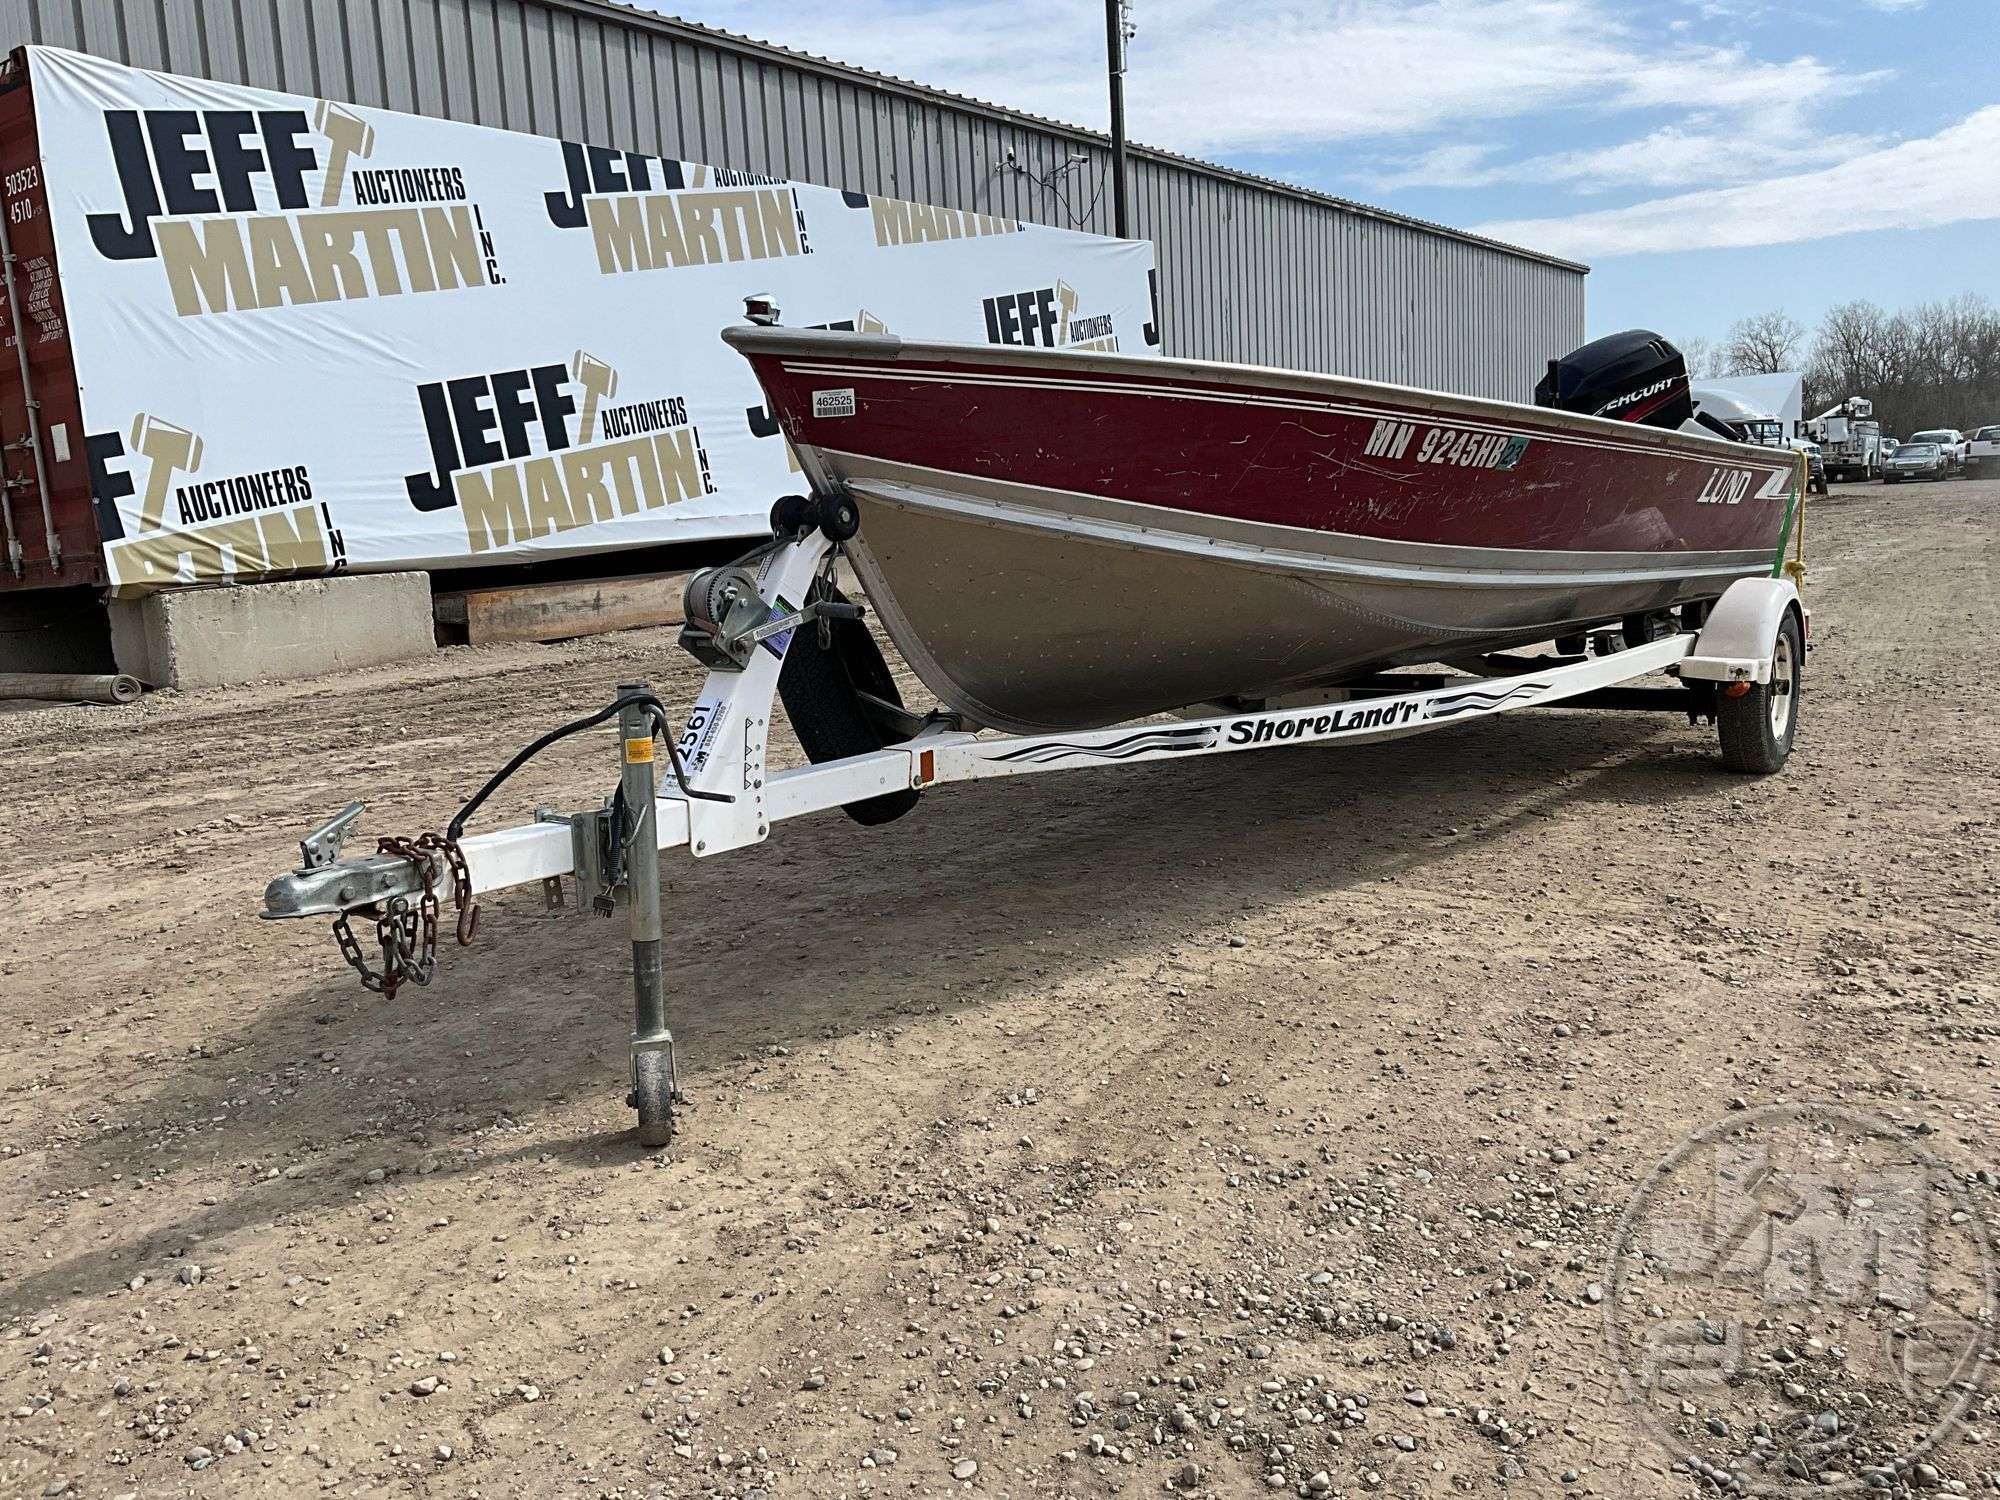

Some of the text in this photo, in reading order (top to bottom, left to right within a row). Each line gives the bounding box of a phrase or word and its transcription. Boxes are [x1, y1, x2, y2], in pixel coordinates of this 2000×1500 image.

[6, 165, 38, 197] 503523
[85, 110, 318, 260] JEFF
[352, 167, 466, 205] AUCTIONEERS
[11, 198, 32, 224] 4510
[586, 188, 801, 275] MARTIN
[792, 187, 814, 255] INC.
[154, 205, 486, 317] MARTIN
[473, 203, 507, 285] INC.
[1069, 313, 1113, 344] AUCTIONEERS
[601, 396, 688, 440] AUCTIONEERS
[816, 395, 852, 407] 462525
[404, 363, 577, 513] JEFF
[692, 425, 718, 495] INC.
[1363, 419, 1509, 470] MN 9245HB
[176, 465, 313, 525] AUCTIONEERS
[455, 428, 703, 554] MARTIN
[1696, 467, 1753, 505] LUND
[676, 706, 711, 763] 2561
[1227, 700, 1419, 745] ShoreLand'r
